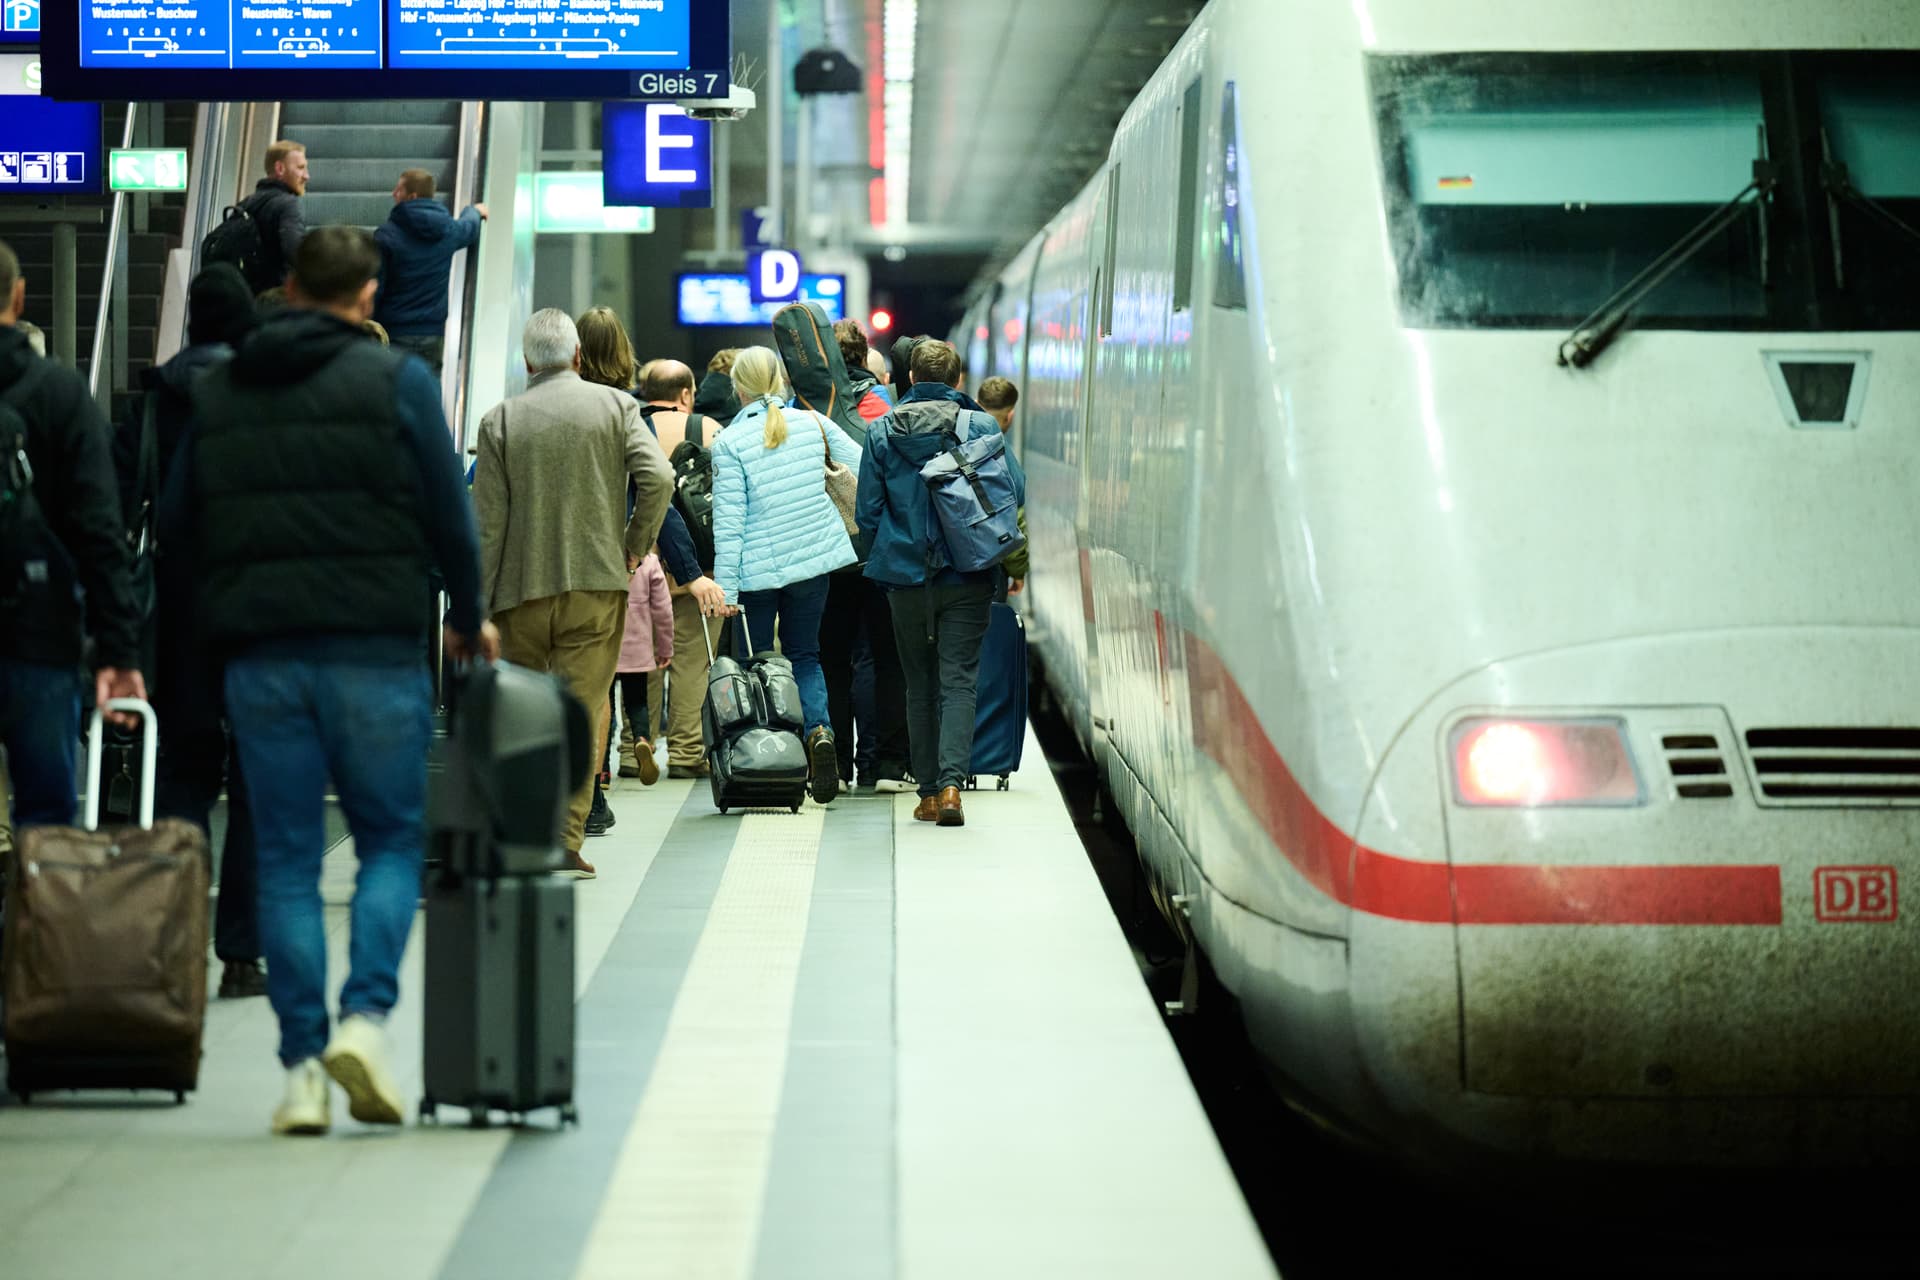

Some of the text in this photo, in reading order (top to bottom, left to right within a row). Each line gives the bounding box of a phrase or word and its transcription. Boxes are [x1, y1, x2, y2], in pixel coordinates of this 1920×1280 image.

[92, 7, 147, 19] Wustermark
[156, 7, 197, 19] Buschow
[242, 7, 293, 19] Neustrelitz
[302, 7, 332, 19] Waren
[454, 0, 487, 11] Leipzig
[488, 0, 506, 9] Hbf
[514, 0, 542, 9] Erfurt
[543, 0, 560, 9] Hbf
[401, 11, 418, 23] Hbf
[427, 11, 483, 23] Donauwörth
[492, 11, 536, 26] Augsburg
[538, 11, 555, 23] Hbf
[564, 11, 640, 26] München-Pasing
[639, 74, 718, 94] Gleis 7
[646, 104, 696, 182] E
[761, 250, 799, 298] D
[1823, 873, 1890, 915] DB
